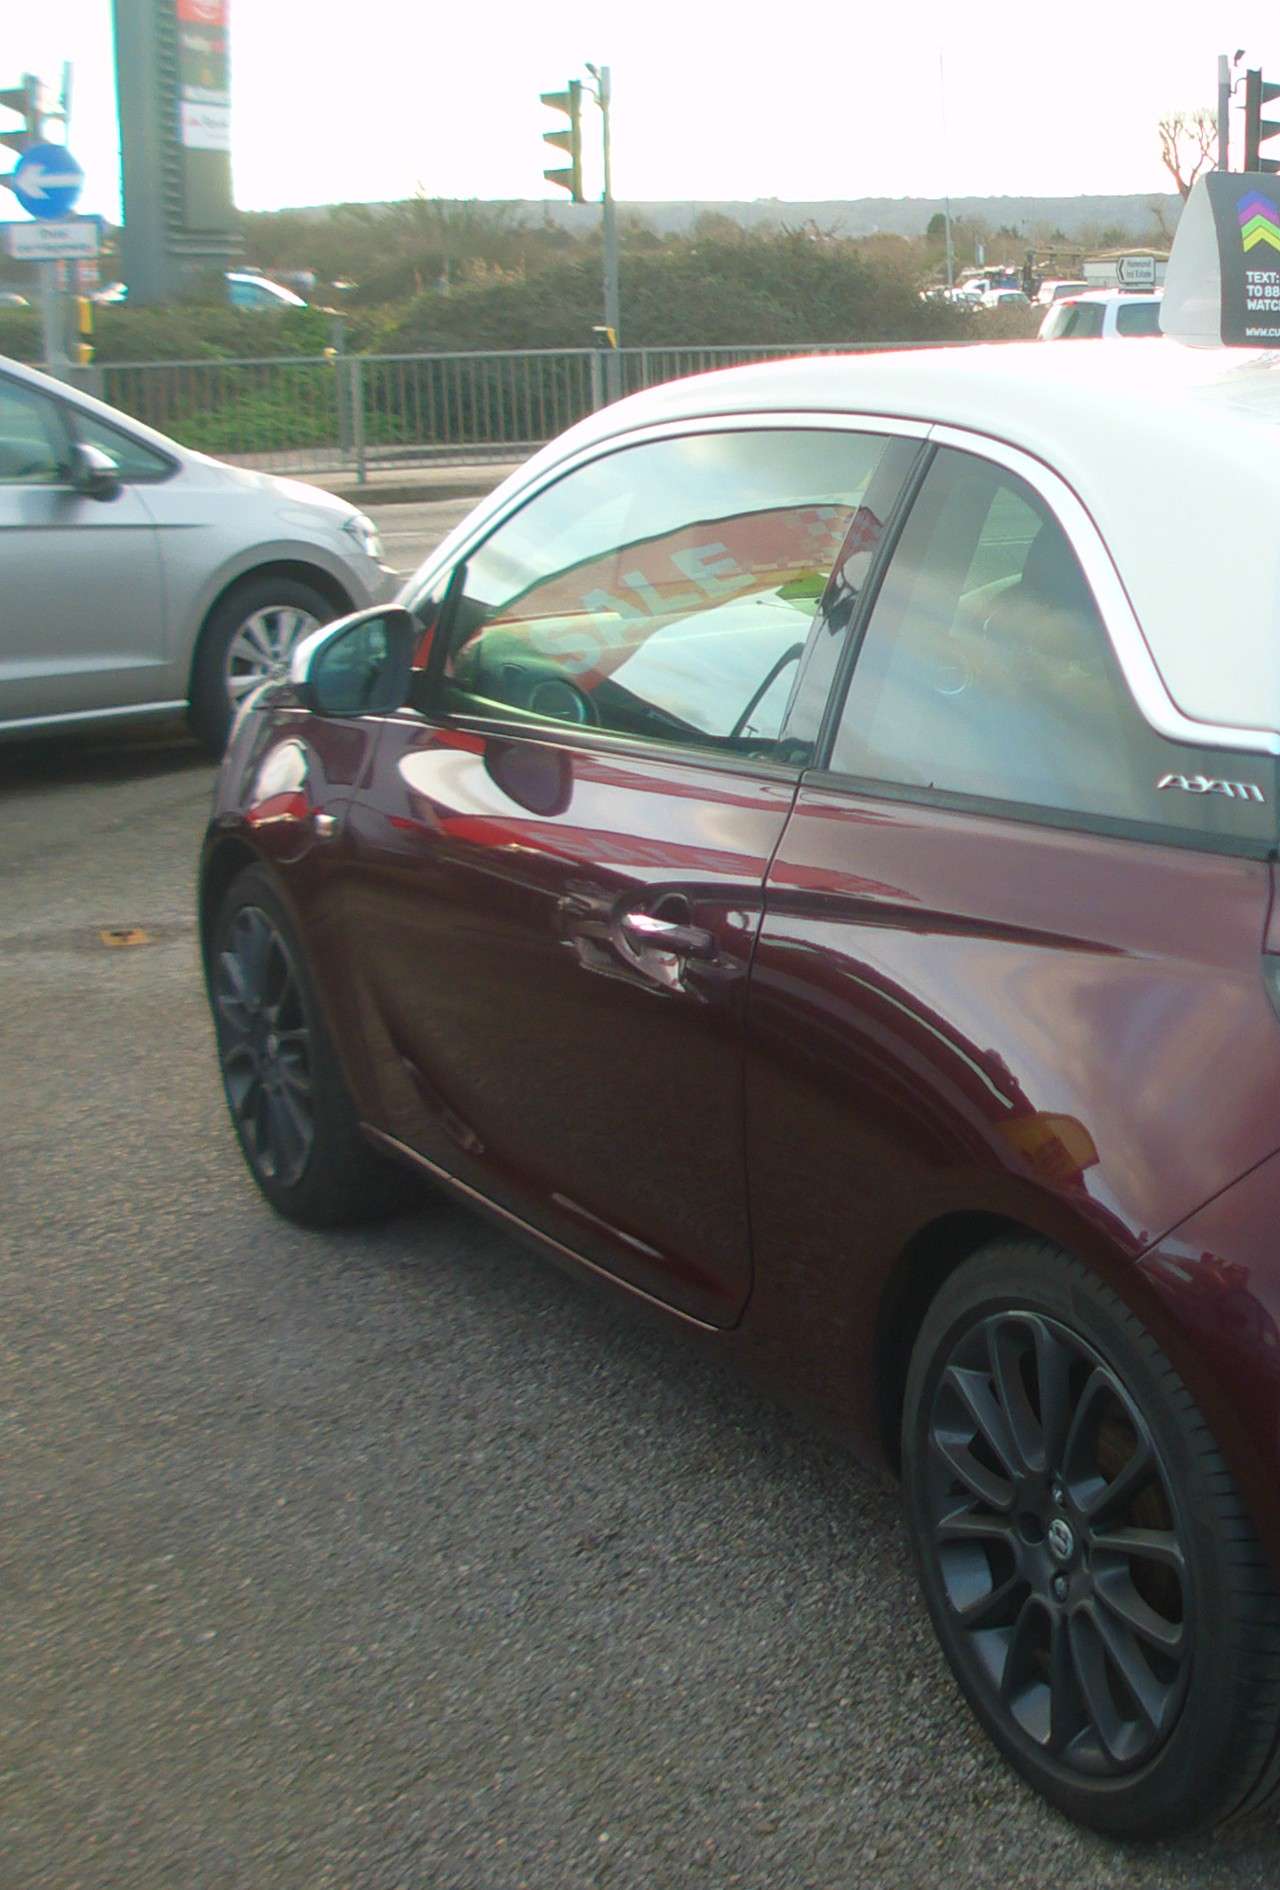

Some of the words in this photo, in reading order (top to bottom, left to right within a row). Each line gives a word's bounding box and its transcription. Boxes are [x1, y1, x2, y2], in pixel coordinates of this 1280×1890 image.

[1246, 271, 1280, 284] TEXT:
[1247, 285, 1263, 297] TO
[529, 542, 758, 675] SALE
